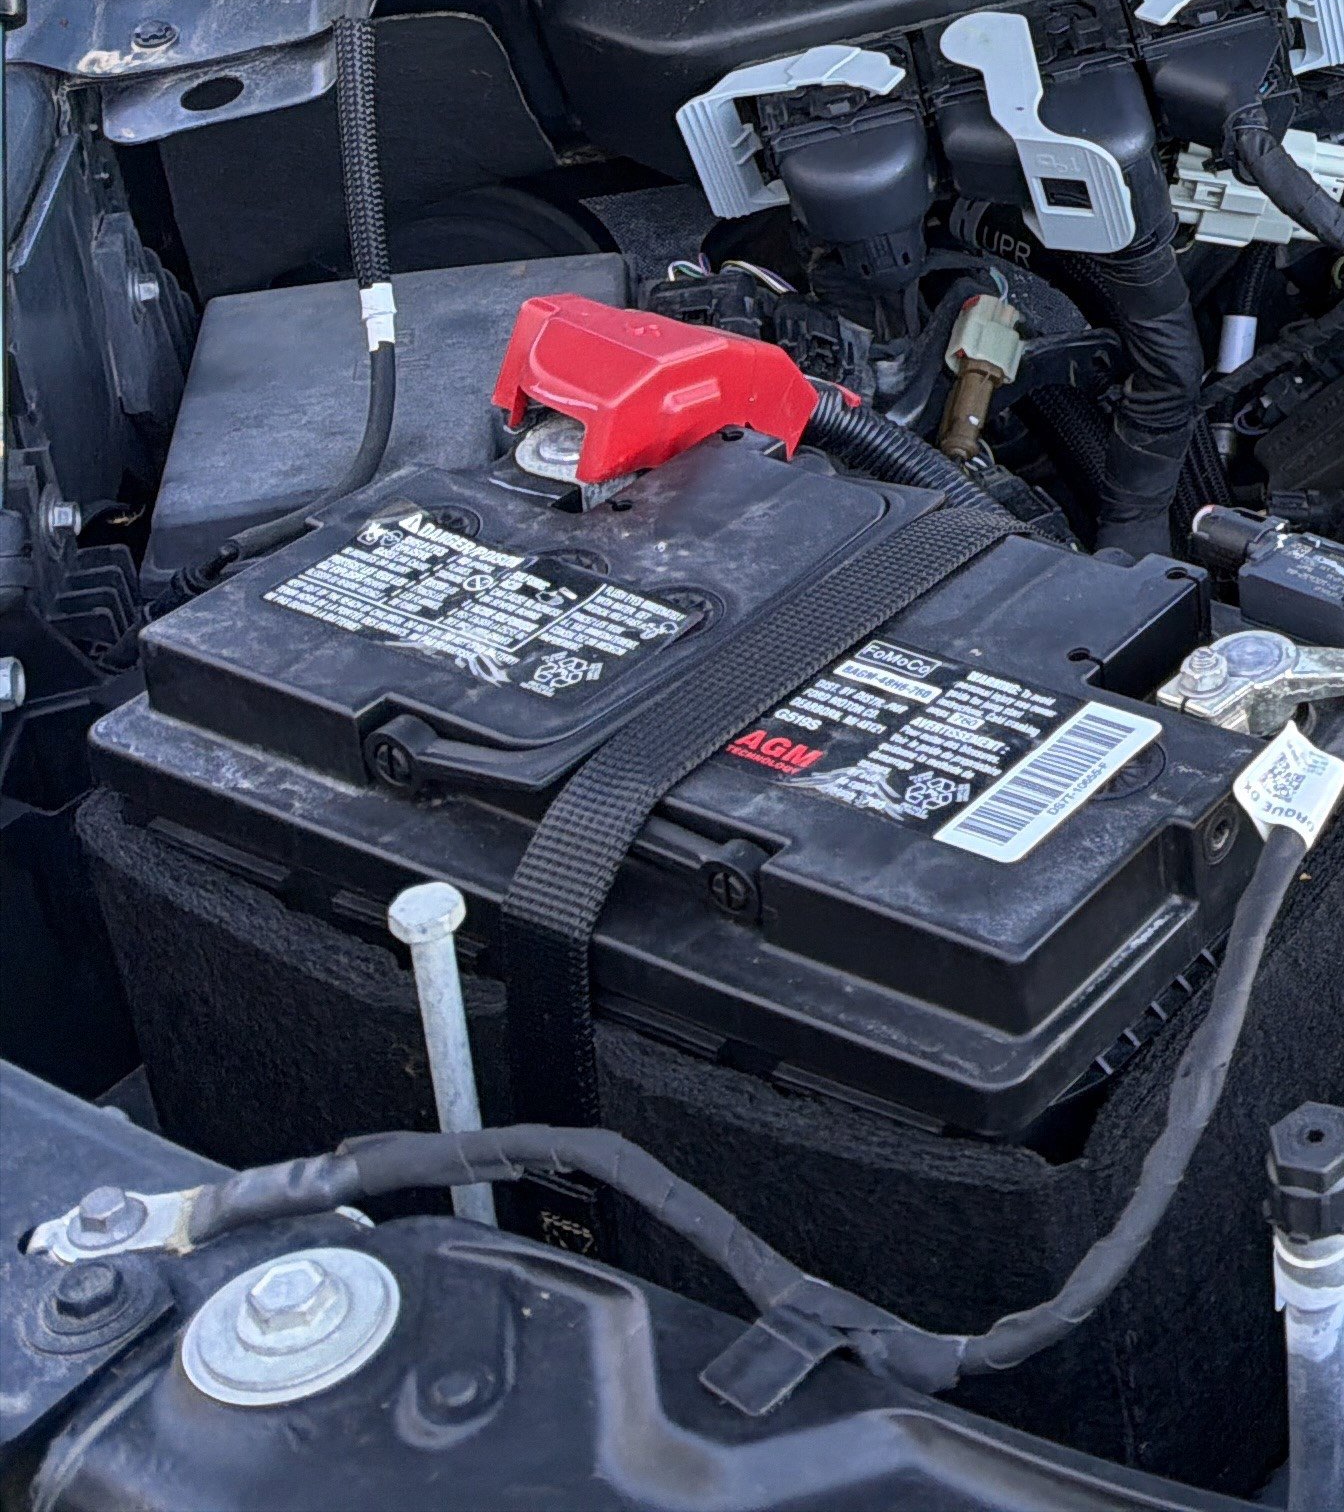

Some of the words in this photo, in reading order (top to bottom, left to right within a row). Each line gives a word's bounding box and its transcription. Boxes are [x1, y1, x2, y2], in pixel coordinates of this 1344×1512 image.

[982, 225, 1031, 269] UPR
[416, 522, 526, 569] DANGER/POISON
[861, 644, 935, 675] FoMoCo
[841, 663, 932, 700] BAGM-48H6-760
[964, 670, 1025, 695] WARNING:
[787, 696, 846, 722] DEARBORN,
[801, 687, 832, 702] FORD
[826, 695, 867, 714] MOTOR
[771, 707, 824, 731] G519S
[908, 713, 1006, 754] AVERTISSEMENT
[952, 714, 978, 727] 760
[723, 743, 801, 777] TECHNOLOGY
[733, 726, 824, 770] AGM
